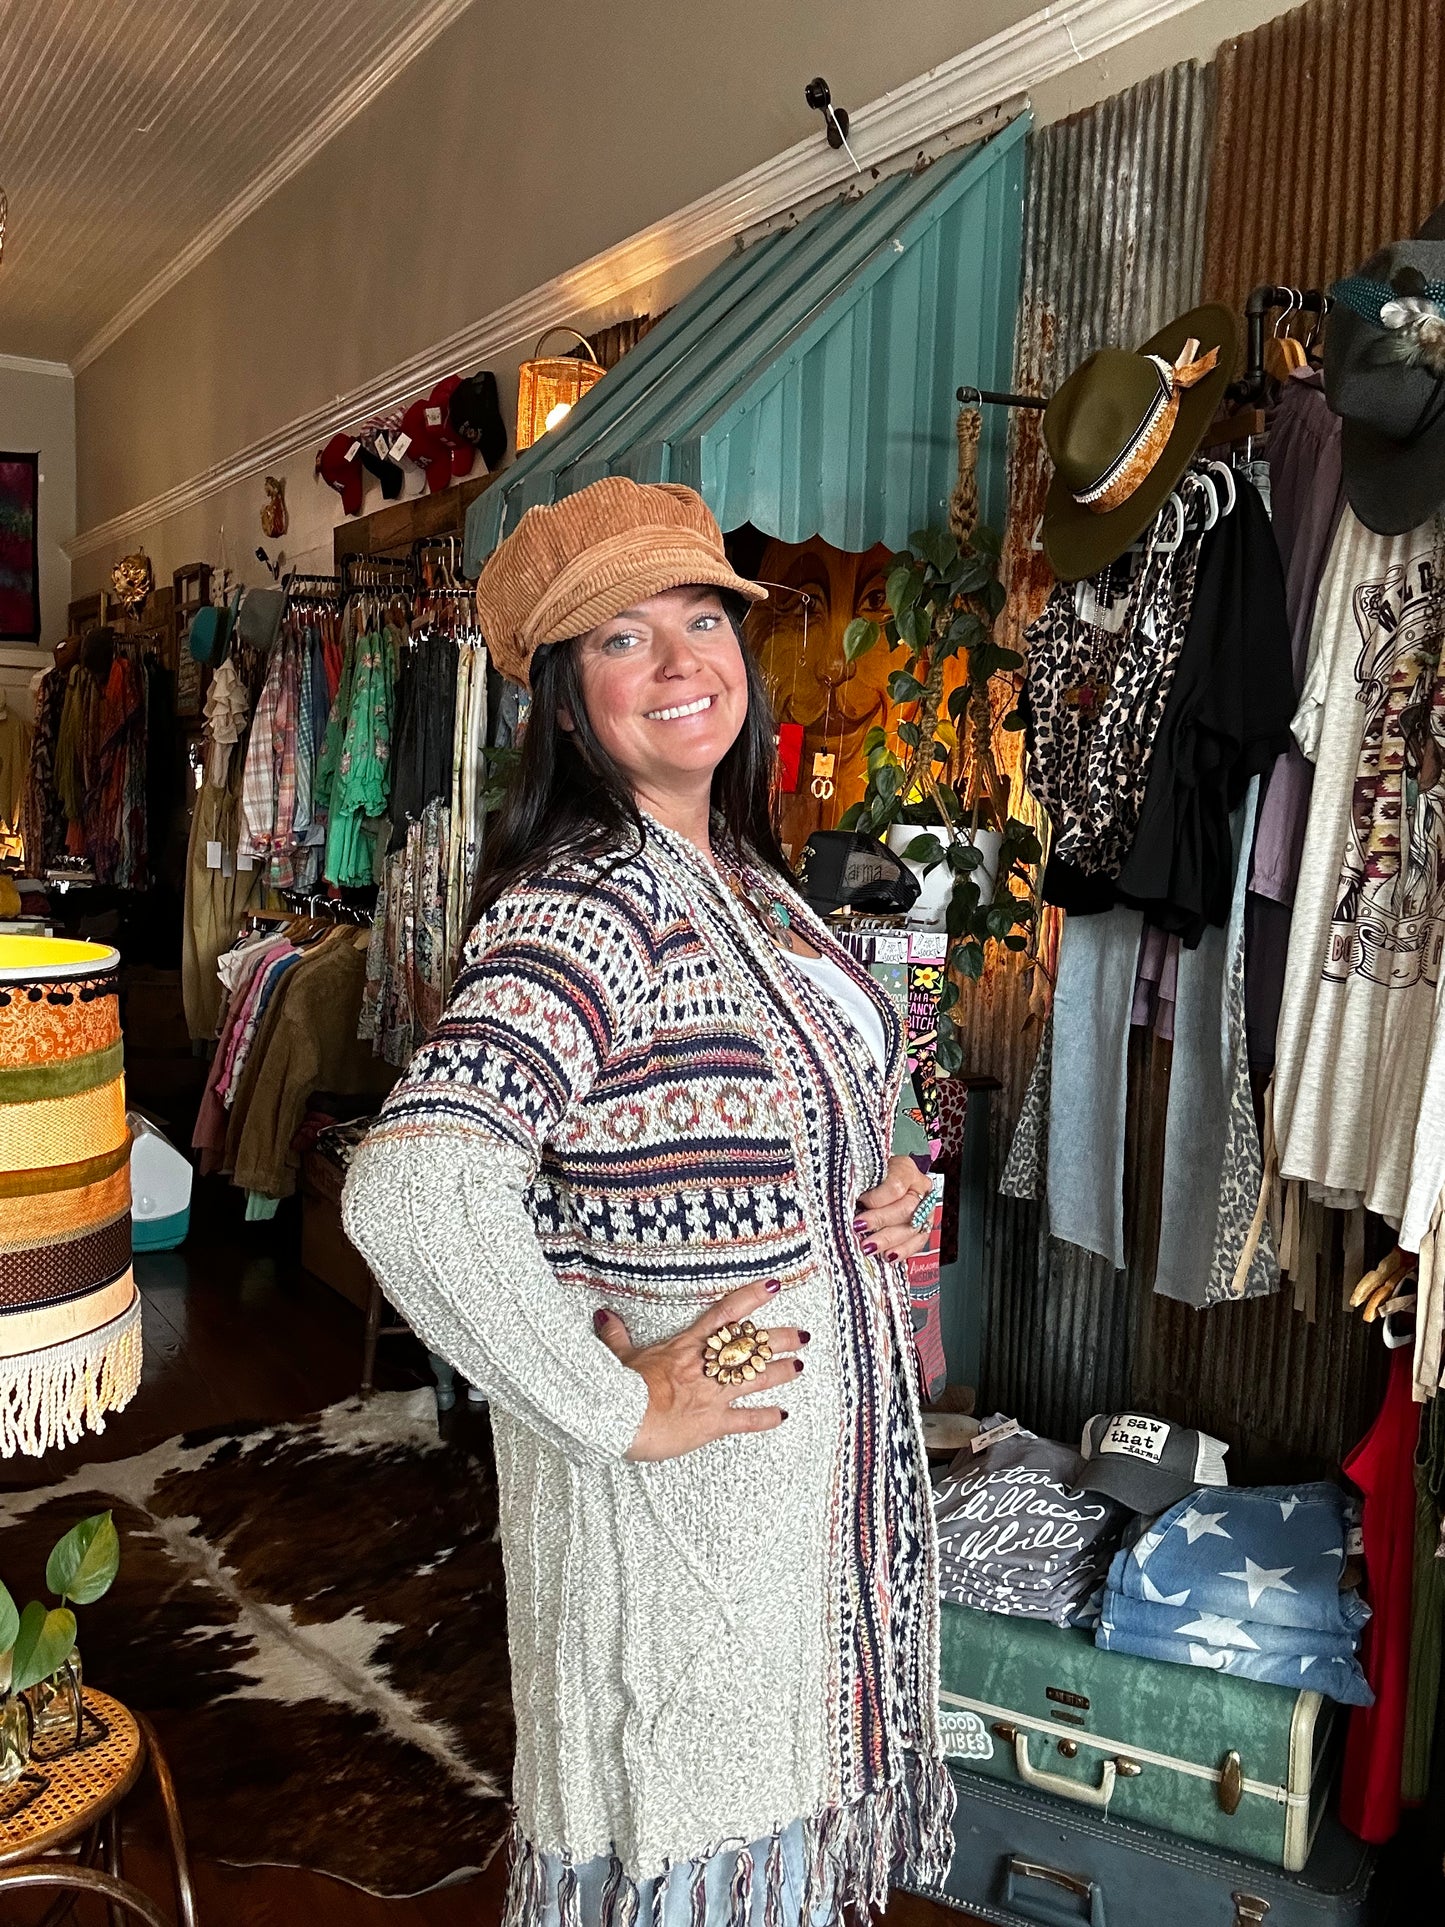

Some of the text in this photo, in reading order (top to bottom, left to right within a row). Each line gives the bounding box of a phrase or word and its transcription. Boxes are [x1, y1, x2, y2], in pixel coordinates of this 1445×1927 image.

[844, 863, 882, 883] arma
[909, 991, 929, 1003] I'M A
[907, 1014, 935, 1031] BITCH
[1112, 1415, 1162, 1433] I saw
[1111, 1430, 1154, 1449] that
[938, 1486, 1106, 1525] dillacs
[939, 1716, 977, 1732] GOOD
